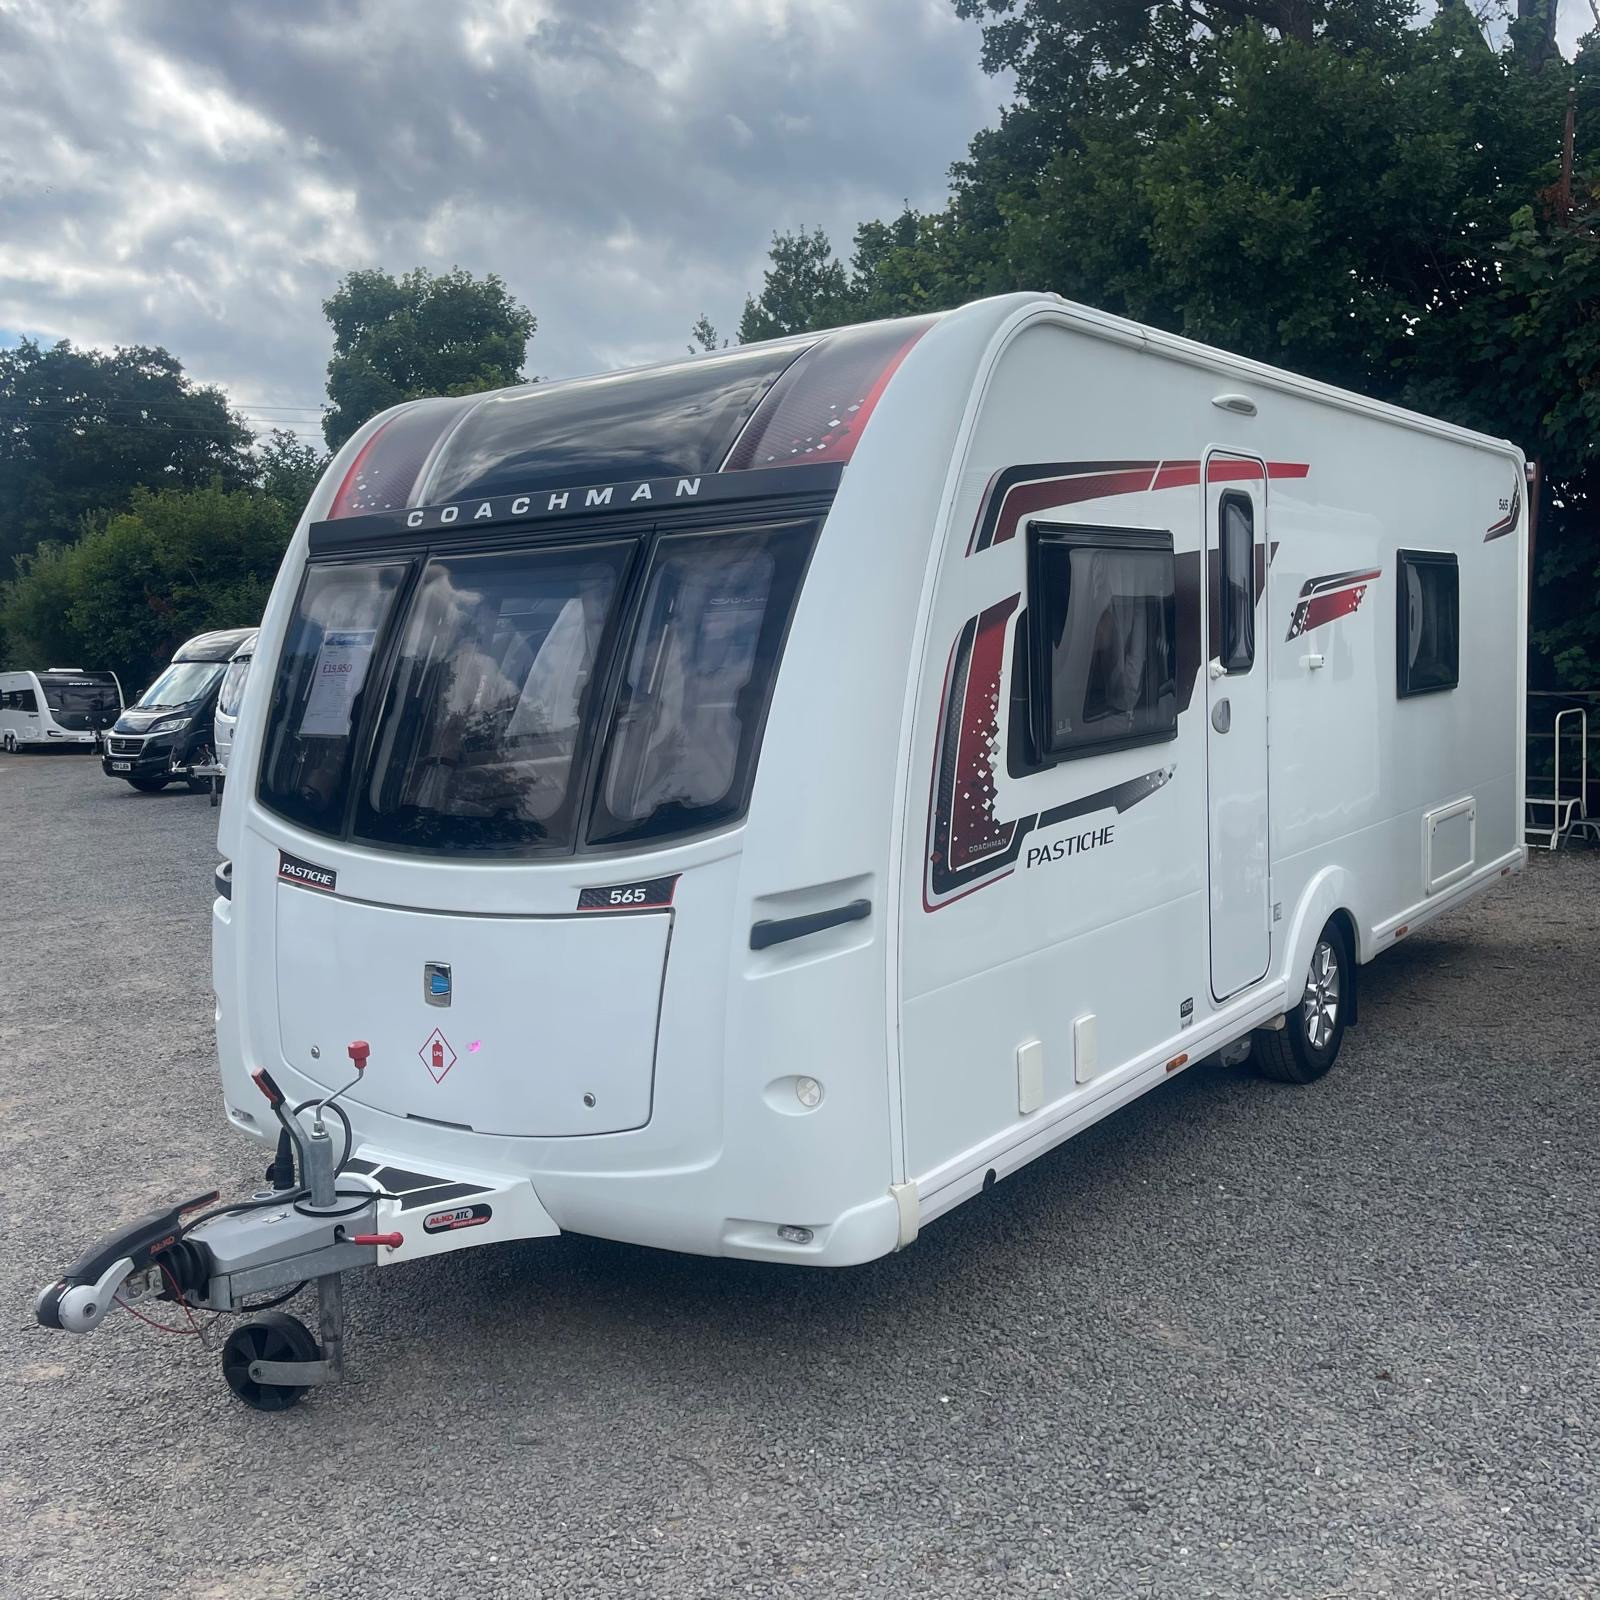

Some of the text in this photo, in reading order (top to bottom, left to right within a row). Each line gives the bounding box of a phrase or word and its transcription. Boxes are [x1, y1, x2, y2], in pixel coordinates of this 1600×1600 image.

[407, 478, 701, 527] COACHMAN
[1499, 498, 1508, 510] 565
[968, 838, 1007, 853] COACHMAN
[1026, 825, 1115, 868] PASTICHE
[282, 863, 334, 885] PASTICHE
[609, 888, 646, 904] 565
[455, 1210, 469, 1220] ATC
